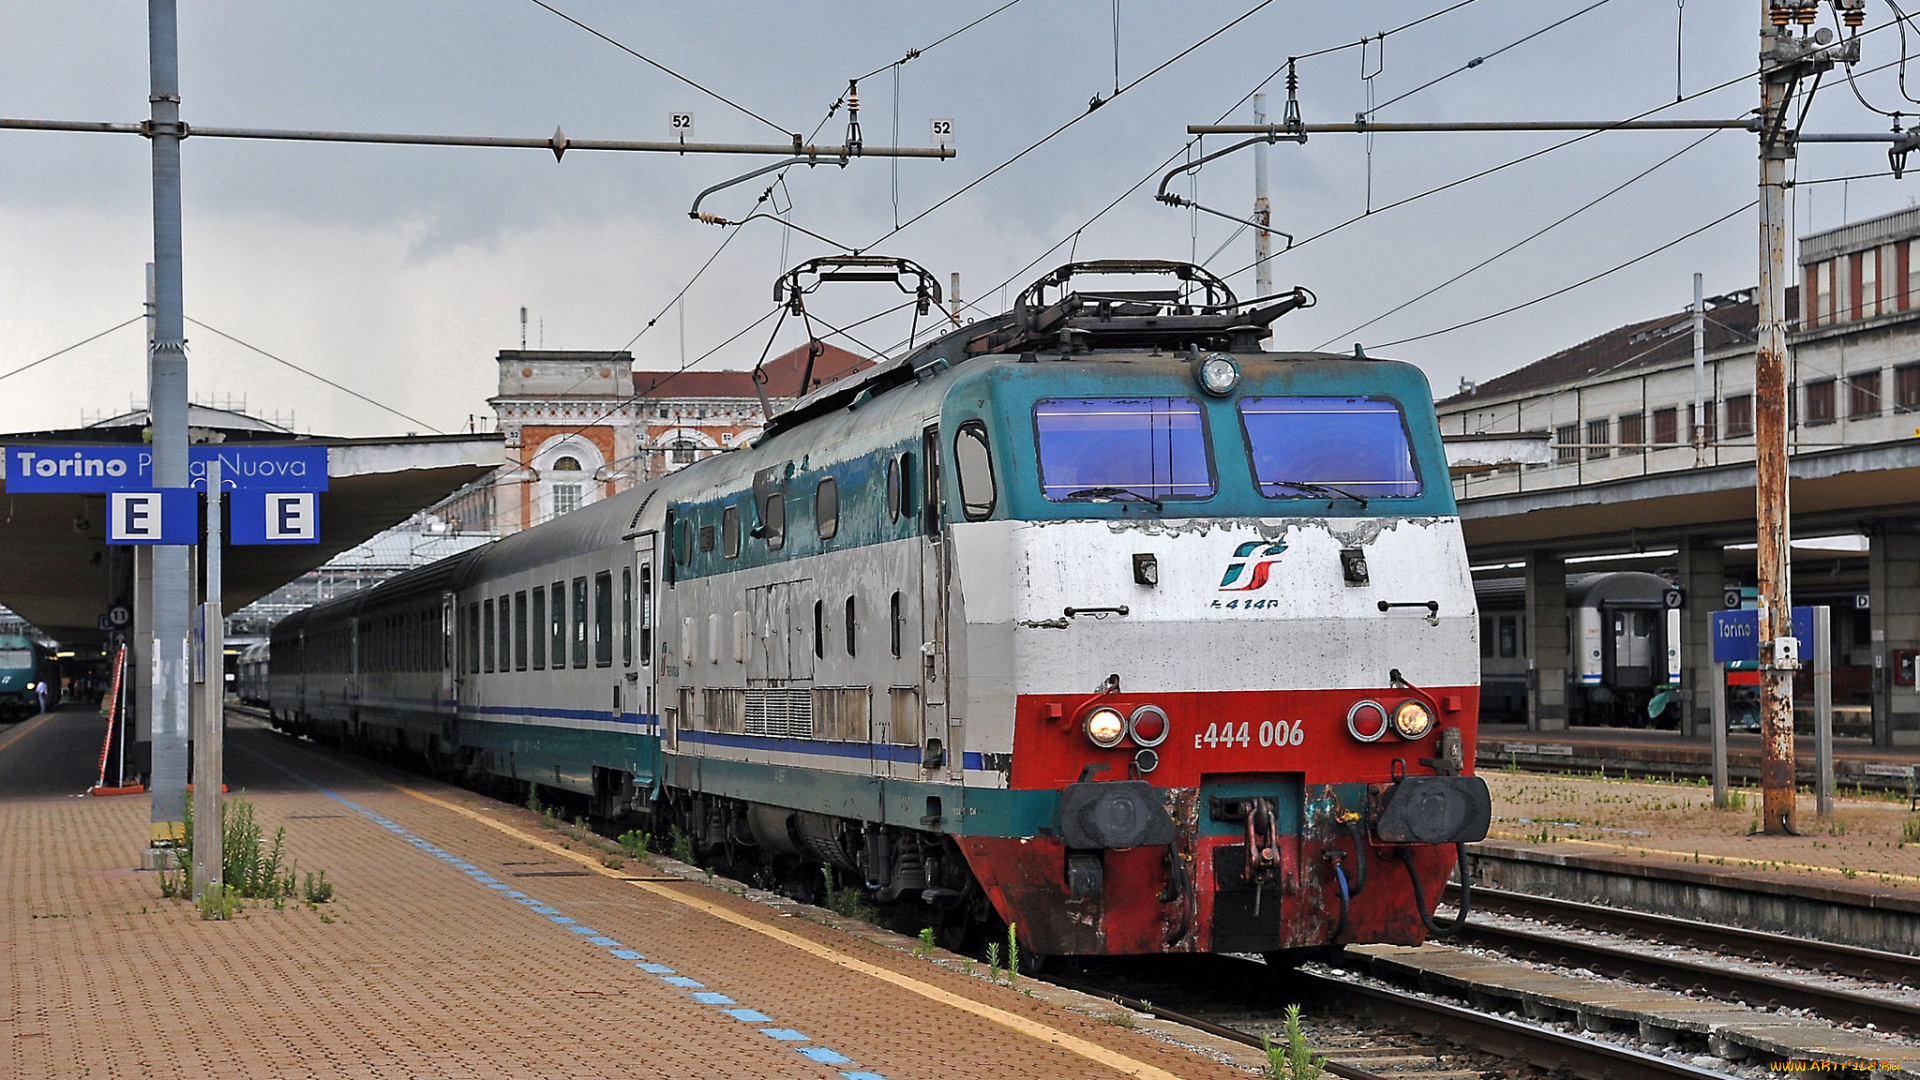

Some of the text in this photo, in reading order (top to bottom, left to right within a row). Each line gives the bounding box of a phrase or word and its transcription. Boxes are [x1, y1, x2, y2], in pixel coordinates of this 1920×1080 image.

[672, 114, 691, 128] 52
[933, 121, 951, 135] 52
[17, 452, 127, 477] Torino
[218, 452, 307, 477] Nuova
[125, 498, 149, 535] E
[278, 498, 301, 535] E
[1669, 593, 1679, 606] 7
[1727, 593, 1736, 605] 6
[1858, 595, 1868, 607] D
[113, 610, 125, 621] 11
[1718, 618, 1751, 638] Torino
[1258, 719, 1304, 747] 006
